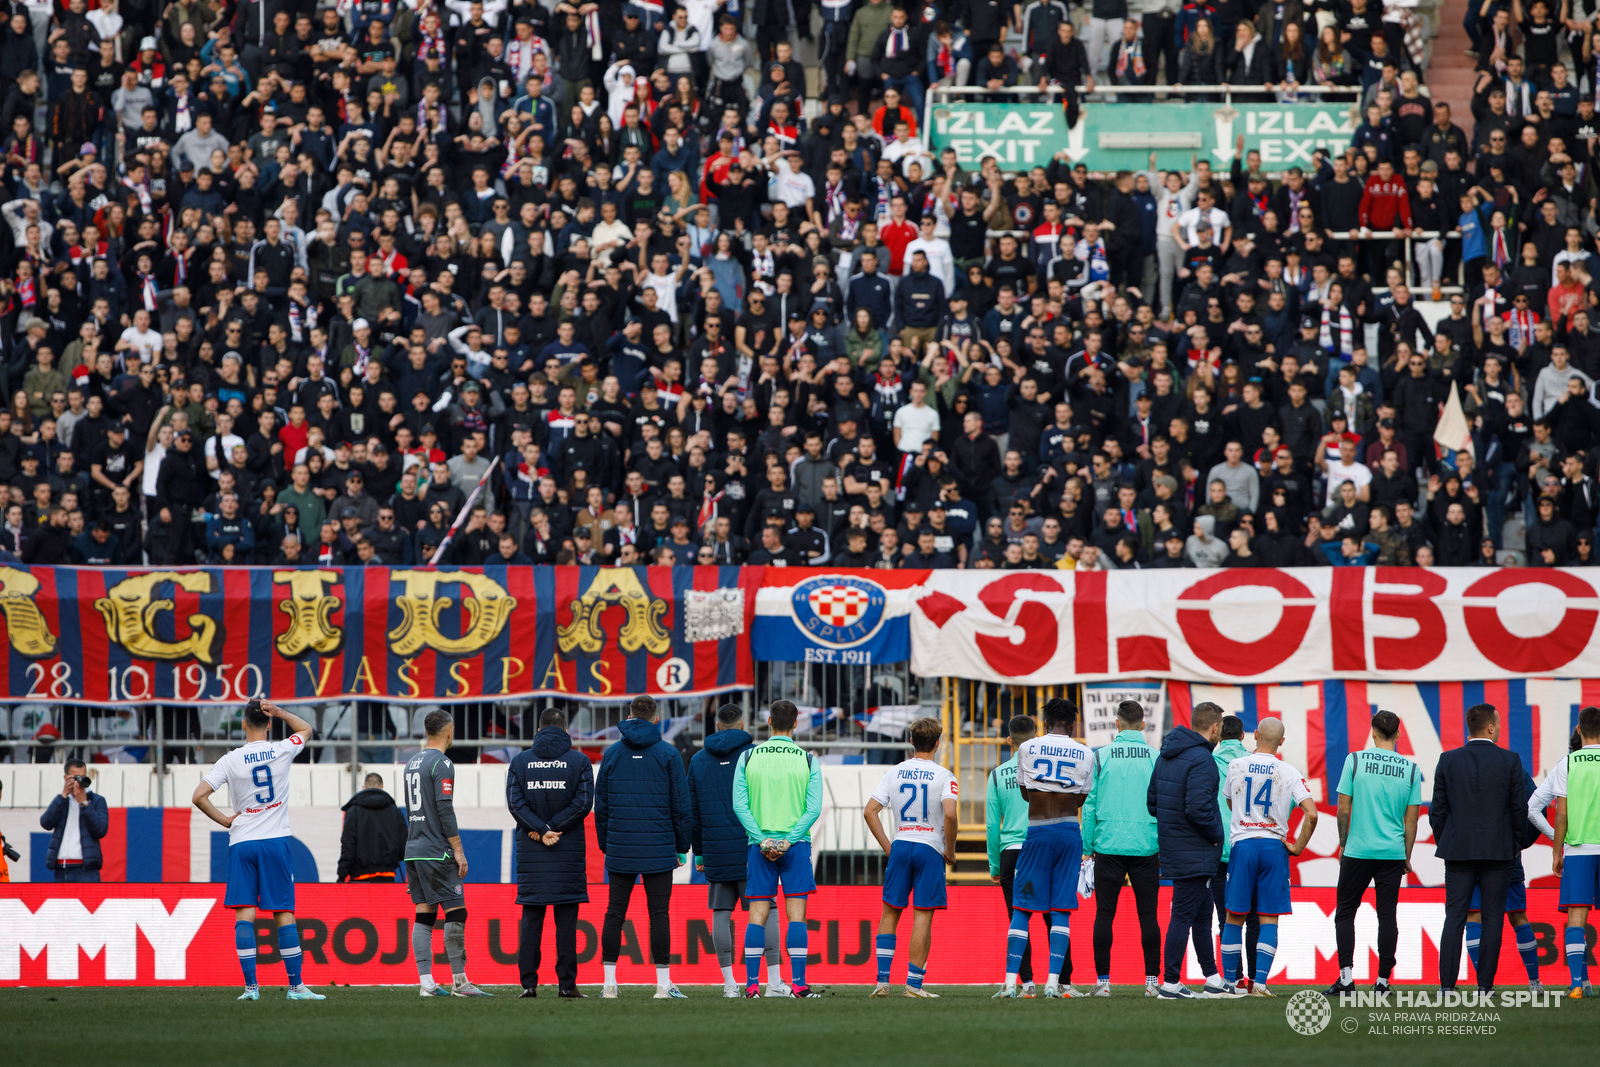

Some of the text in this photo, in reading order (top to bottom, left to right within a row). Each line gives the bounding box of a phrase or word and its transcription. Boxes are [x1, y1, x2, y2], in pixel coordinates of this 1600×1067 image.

[937, 111, 1054, 134] IZLAZ
[1246, 111, 1355, 134] IZLAZ
[950, 139, 1041, 163] EXIT
[805, 616, 869, 643] SPLIT
[805, 648, 871, 664] EST. 1911
[25, 661, 266, 700] 28. 10. 1950.
[244, 748, 276, 764] KALINIĆ
[756, 746, 803, 757] macron
[1029, 745, 1085, 760] C. AWAZIEM
[1111, 747, 1150, 758] HAJDUK
[1362, 752, 1409, 766] macron
[528, 760, 567, 769] macron
[897, 768, 935, 780] PUKŠTAS
[1033, 759, 1076, 788] 25
[1248, 763, 1274, 774] GRGIĆ
[1365, 762, 1405, 778] HAJDUK
[252, 765, 274, 804] 9
[406, 772, 422, 812] 13
[527, 781, 566, 790] HAJDUK
[900, 784, 928, 822] 21
[1245, 777, 1272, 817] 14
[1240, 820, 1277, 829] SuperSport
[0, 898, 216, 979] MMY
[254, 918, 409, 965] BROJ
[556, 919, 871, 965] DAMCIJ
